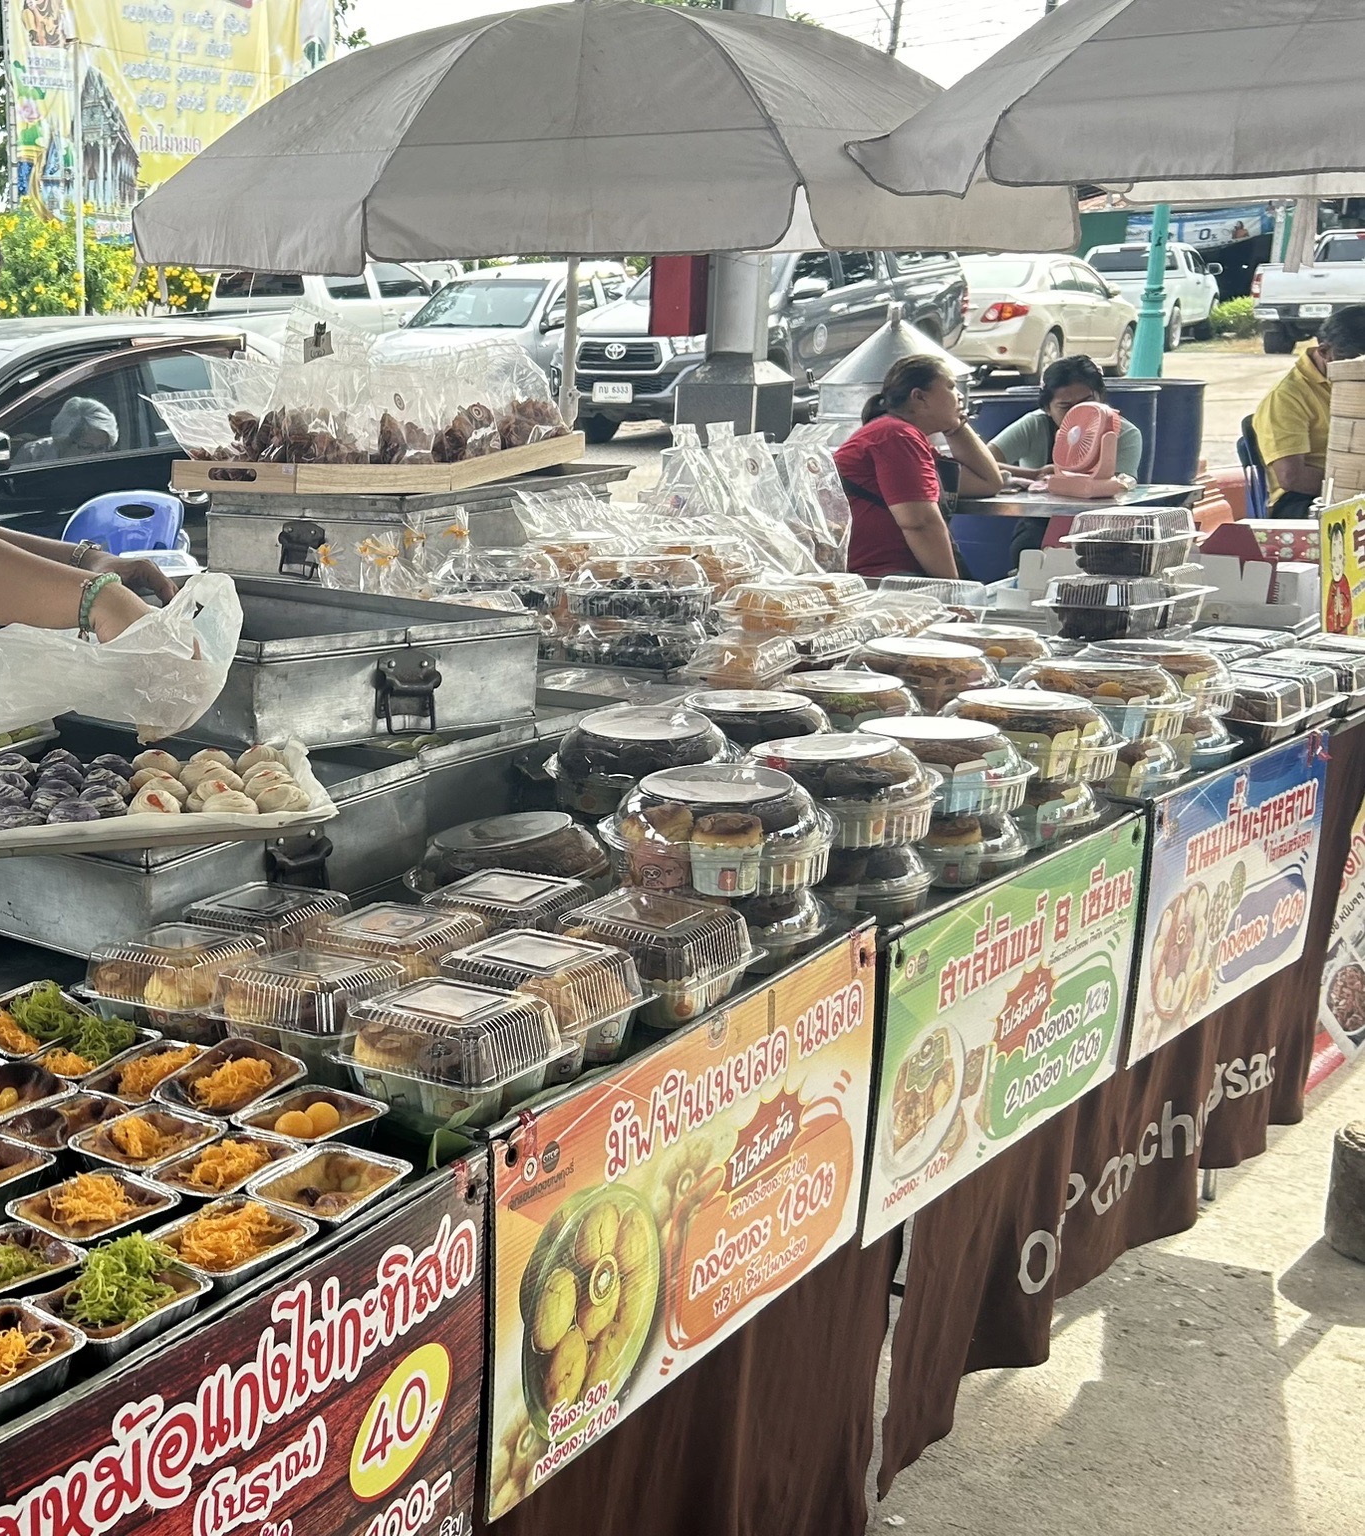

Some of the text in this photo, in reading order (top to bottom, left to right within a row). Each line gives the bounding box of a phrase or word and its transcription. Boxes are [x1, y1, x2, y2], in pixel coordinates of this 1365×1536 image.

[1054, 896, 1071, 943] 8
[795, 984, 865, 1054] นมสด
[1025, 1010, 1080, 1059] กล่องละ
[730, 1102, 794, 1188] โปรโมชั่น
[692, 1219, 770, 1297] กล่องละ
